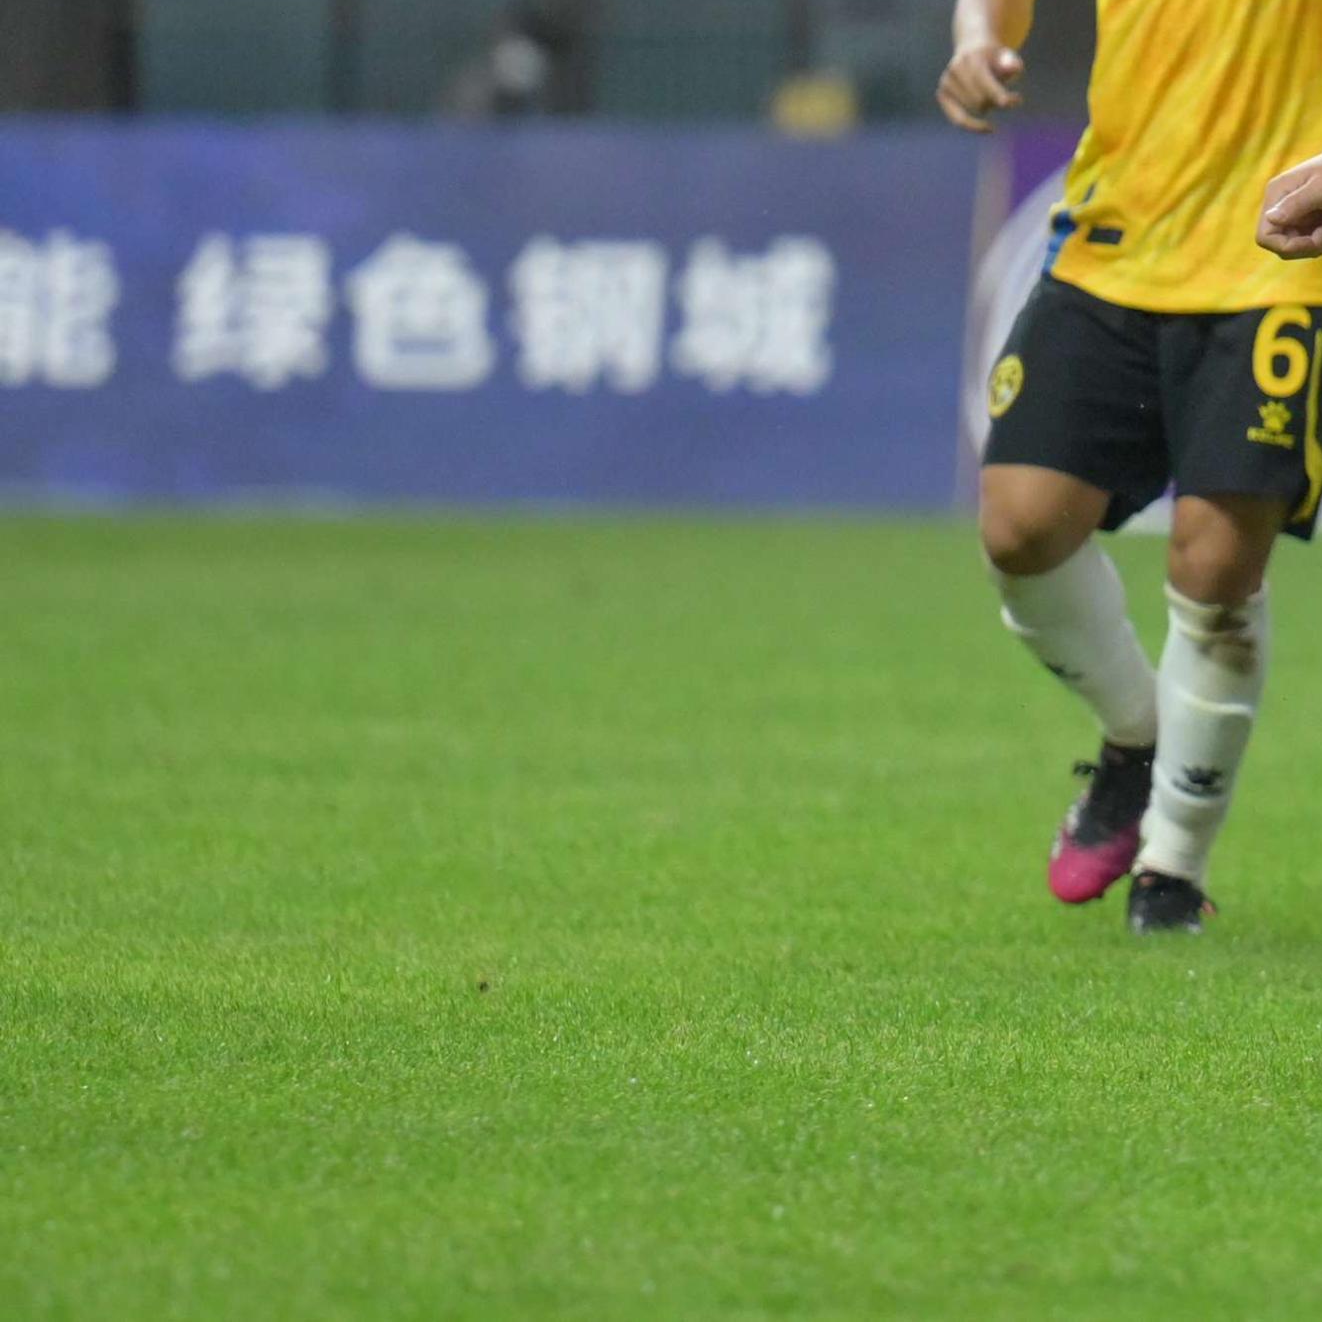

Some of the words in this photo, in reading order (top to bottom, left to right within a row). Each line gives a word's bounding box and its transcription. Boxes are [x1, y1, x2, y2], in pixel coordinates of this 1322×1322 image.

[172, 231, 838, 395] 绿色钢城
[1252, 304, 1312, 398] 6
